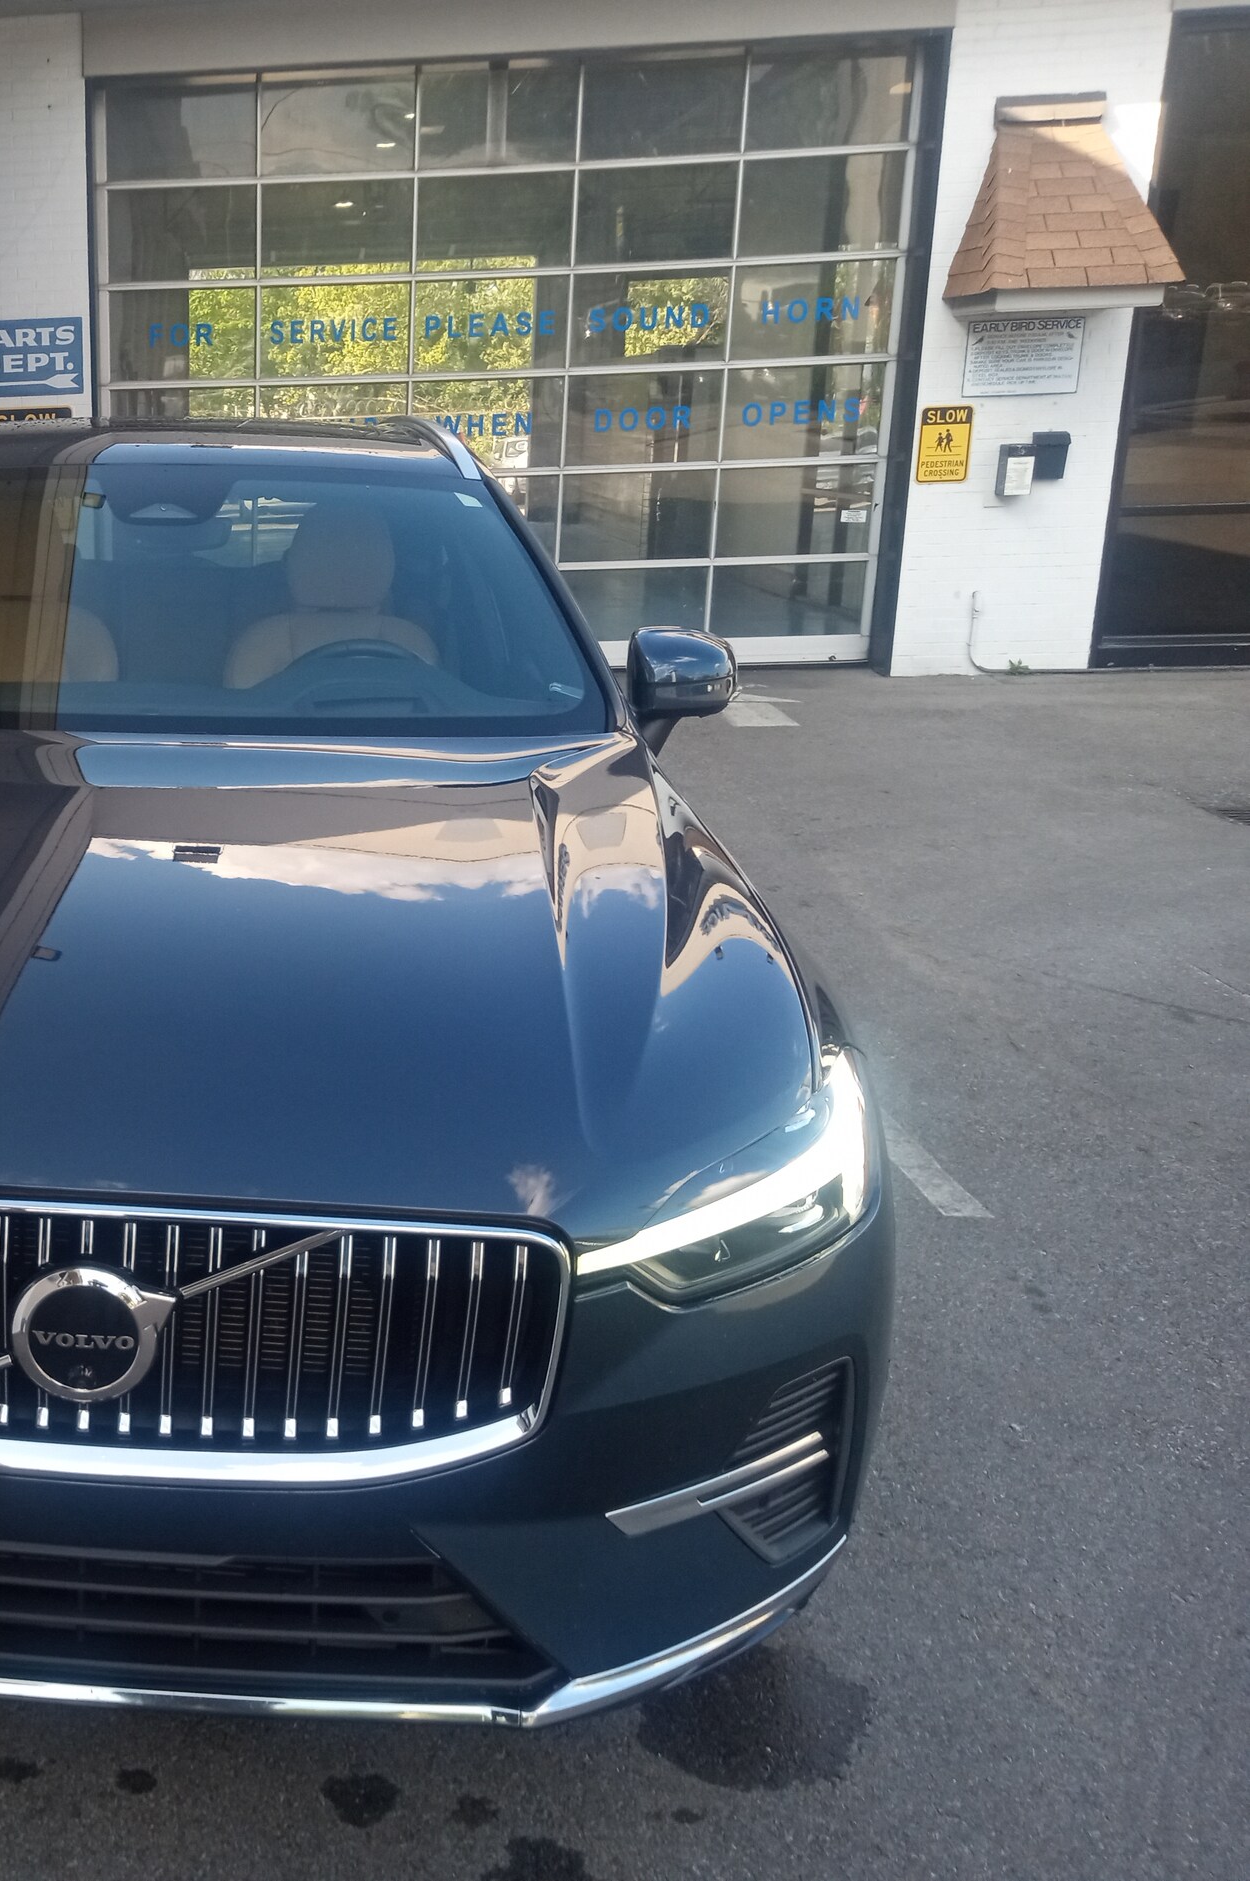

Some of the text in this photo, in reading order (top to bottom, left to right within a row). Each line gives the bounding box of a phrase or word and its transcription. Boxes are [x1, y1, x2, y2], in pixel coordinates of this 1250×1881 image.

[148, 295, 860, 347] FOR SERVICE PLEASE SOUND HORN
[972, 319, 1082, 333] EARLY BIRD SERVICE
[435, 397, 861, 437] WHEN DOOR OPENS
[926, 409, 968, 423] SLOW
[921, 460, 965, 468] PEDESTRIAN
[923, 469, 959, 477] CROSSING
[31, 1330, 135, 1350] VOLVO
